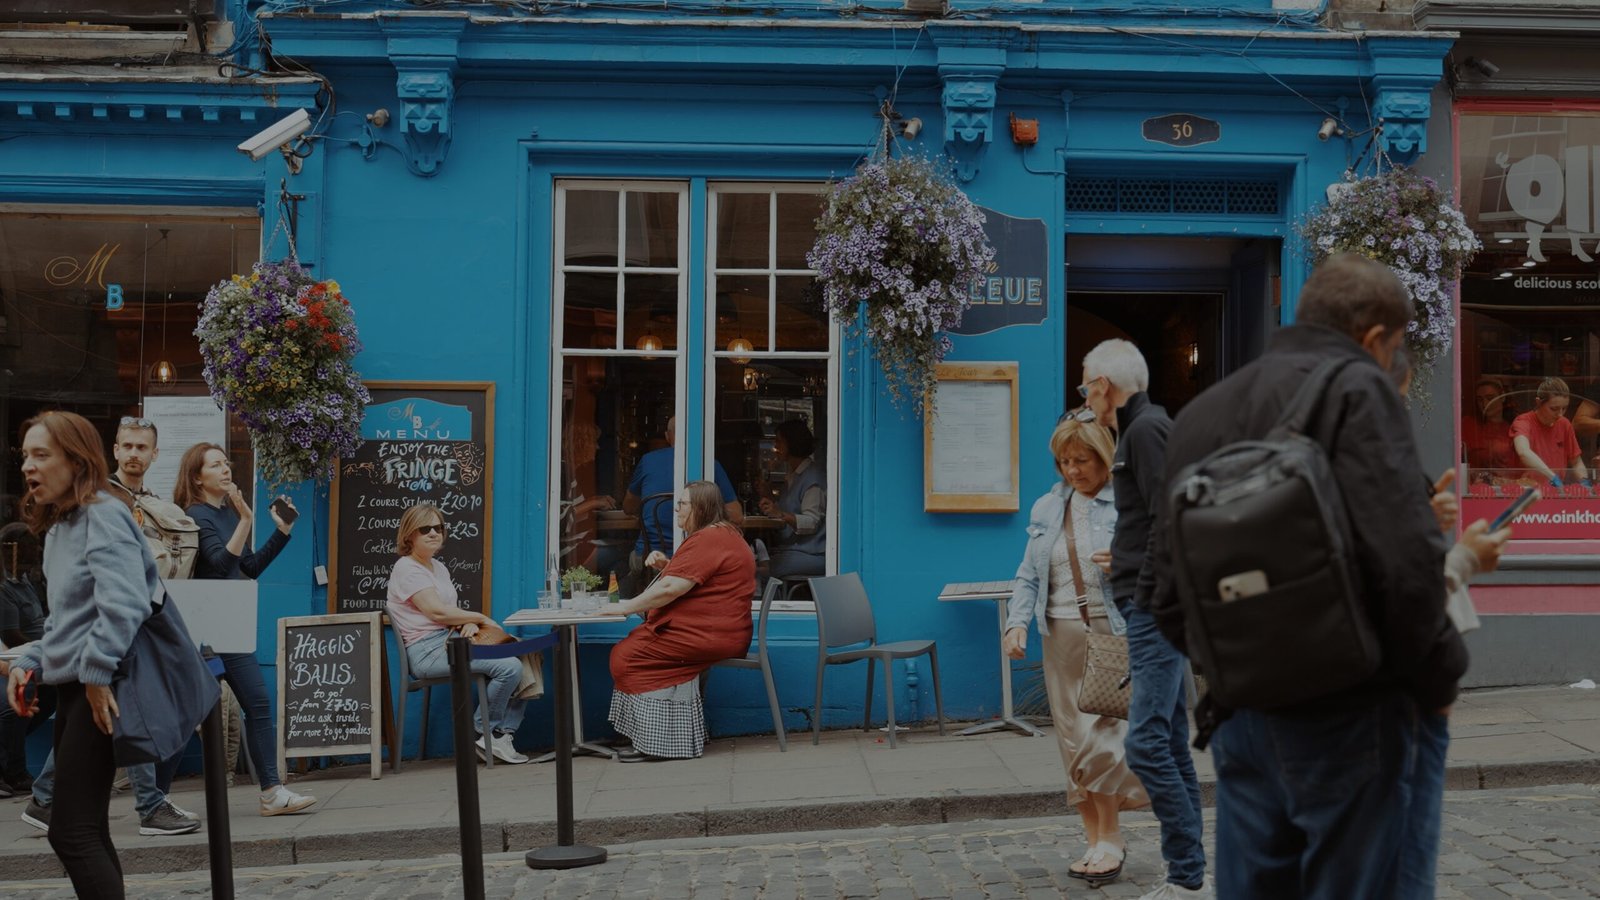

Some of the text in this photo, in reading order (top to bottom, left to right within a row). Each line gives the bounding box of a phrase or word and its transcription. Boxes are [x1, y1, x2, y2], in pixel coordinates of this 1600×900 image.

[1172, 121, 1193, 140] 36
[1513, 276, 1572, 289] delicious
[969, 277, 1043, 305] LEUE
[376, 429, 451, 440] MENU
[377, 441, 450, 458] ENJOY THE
[383, 456, 458, 485] FRINGE
[357, 495, 366, 508] 2
[369, 498, 399, 507] COURSE
[400, 496, 415, 510] SET
[357, 516, 401, 530] 2 COURSE
[448, 520, 479, 540] £25
[352, 565, 373, 576] Follow
[342, 599, 387, 609] FOOD FIR
[294, 633, 355, 659] HAGGIS
[293, 662, 351, 687] BALLS
[313, 687, 344, 702] to go!
[299, 698, 319, 712] from
[290, 712, 360, 726] please ask inside
[287, 726, 302, 740] for
[303, 728, 322, 738] more
[342, 724, 371, 740] goodies
